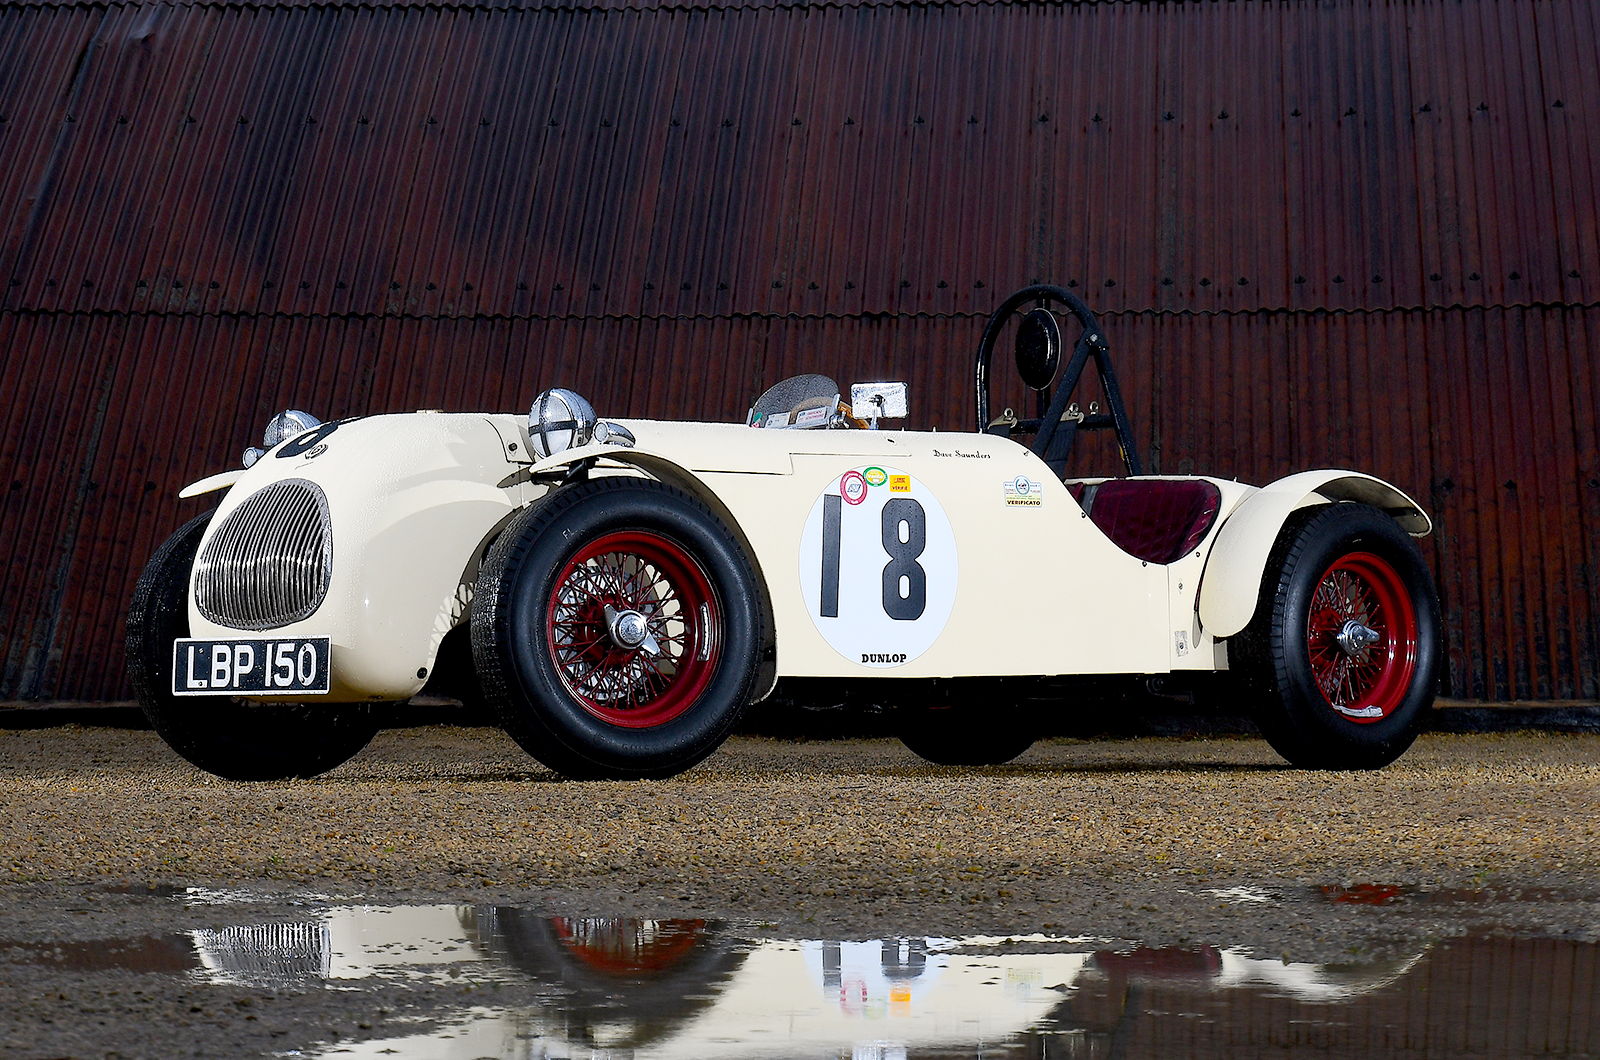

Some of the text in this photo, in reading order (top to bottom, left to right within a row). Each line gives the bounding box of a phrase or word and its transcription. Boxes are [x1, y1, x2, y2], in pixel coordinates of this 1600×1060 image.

[932, 449, 991, 459] Dave Saunders
[820, 493, 927, 621] 18
[186, 642, 317, 689] LBP 150
[861, 653, 907, 664] DUNLOP
